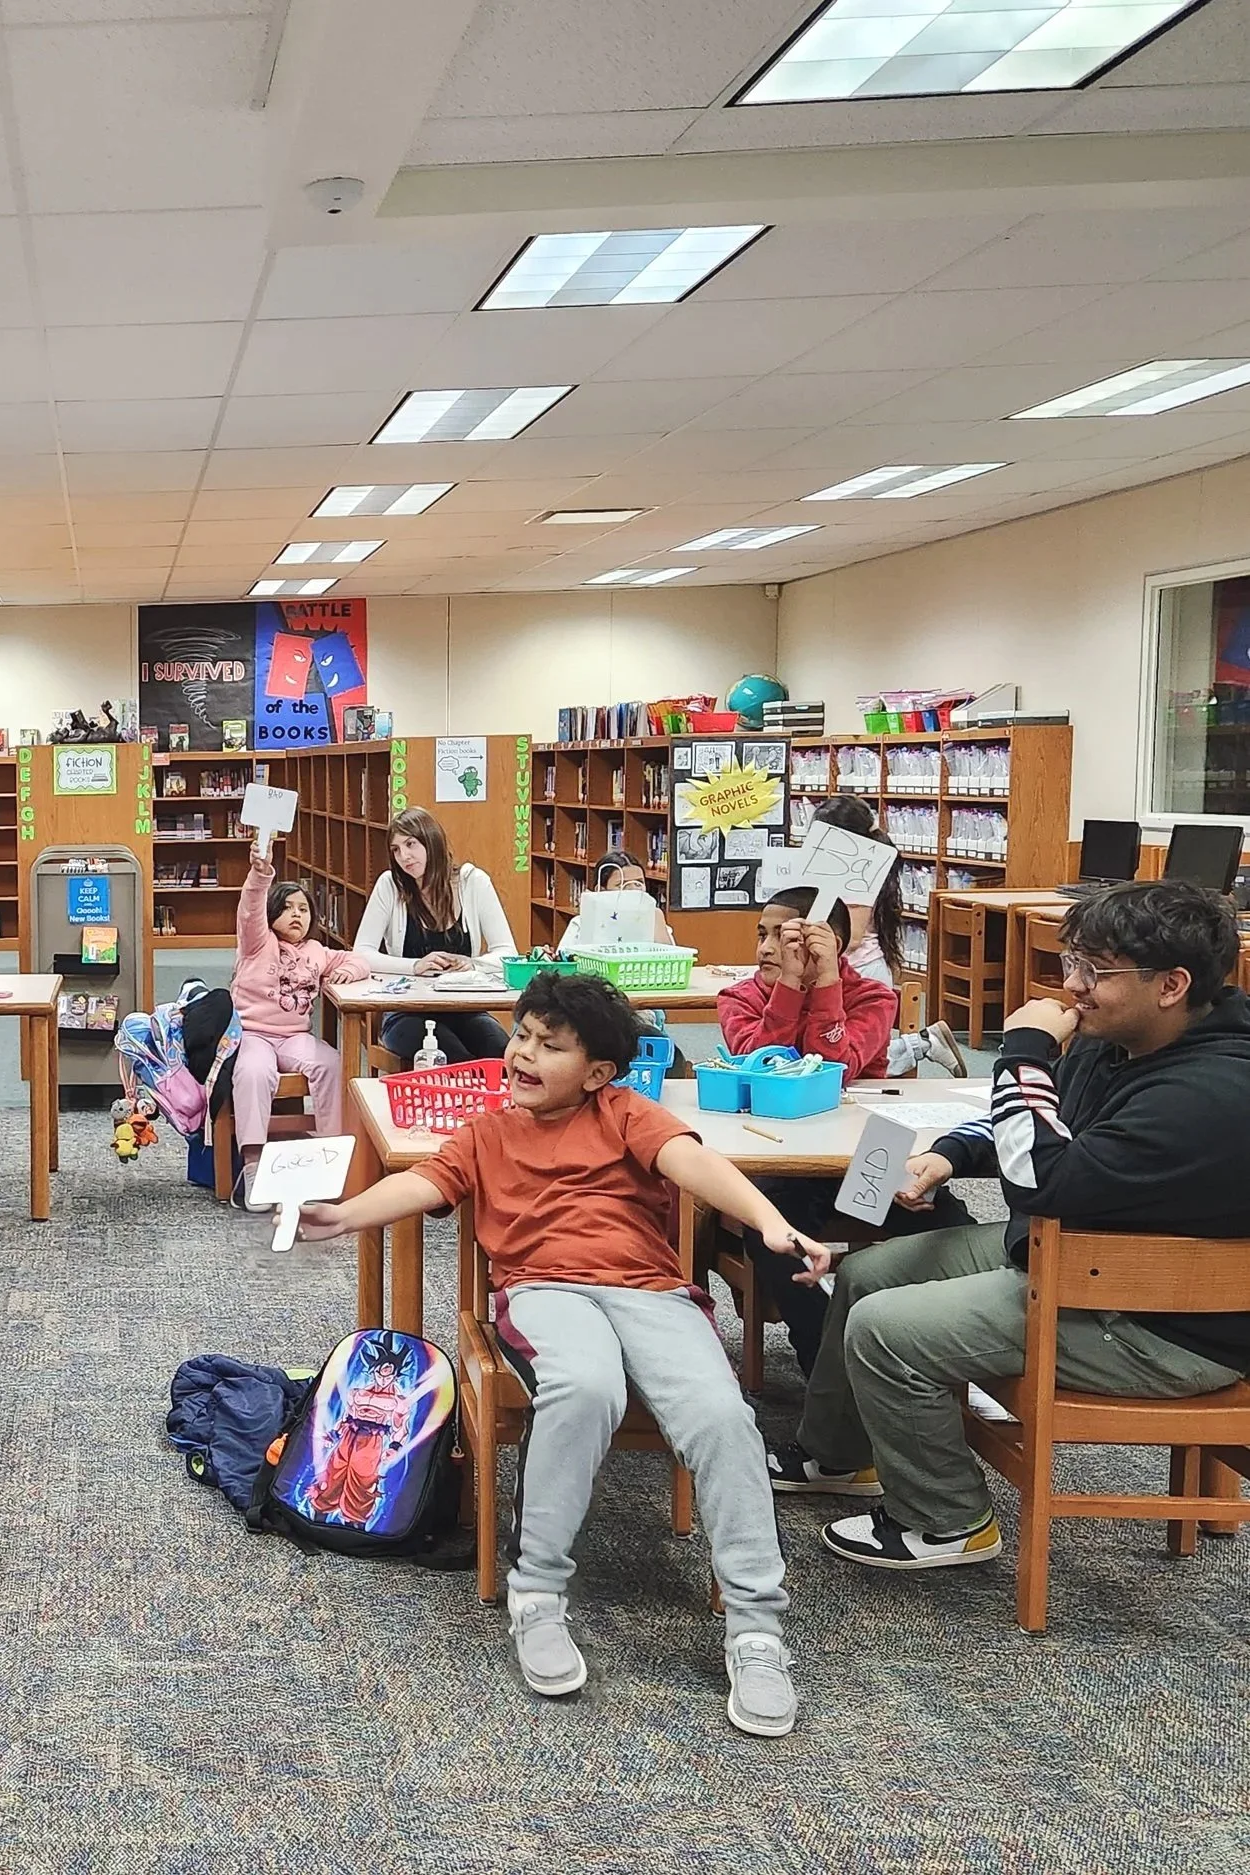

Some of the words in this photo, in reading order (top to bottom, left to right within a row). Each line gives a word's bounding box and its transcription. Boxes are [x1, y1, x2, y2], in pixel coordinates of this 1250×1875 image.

[285, 602, 352, 617] BATTLE
[141, 662, 149, 682] I
[154, 660, 245, 682] SURVIVED
[265, 700, 283, 714] of
[291, 699, 319, 714] the
[258, 725, 329, 740] BOOKS
[699, 781, 755, 808] GRAPHIC
[710, 794, 759, 817] NOVELS
[78, 894, 100, 902] CALM
[79, 887, 98, 895] KEEP
[852, 1148, 889, 1209] BAD
